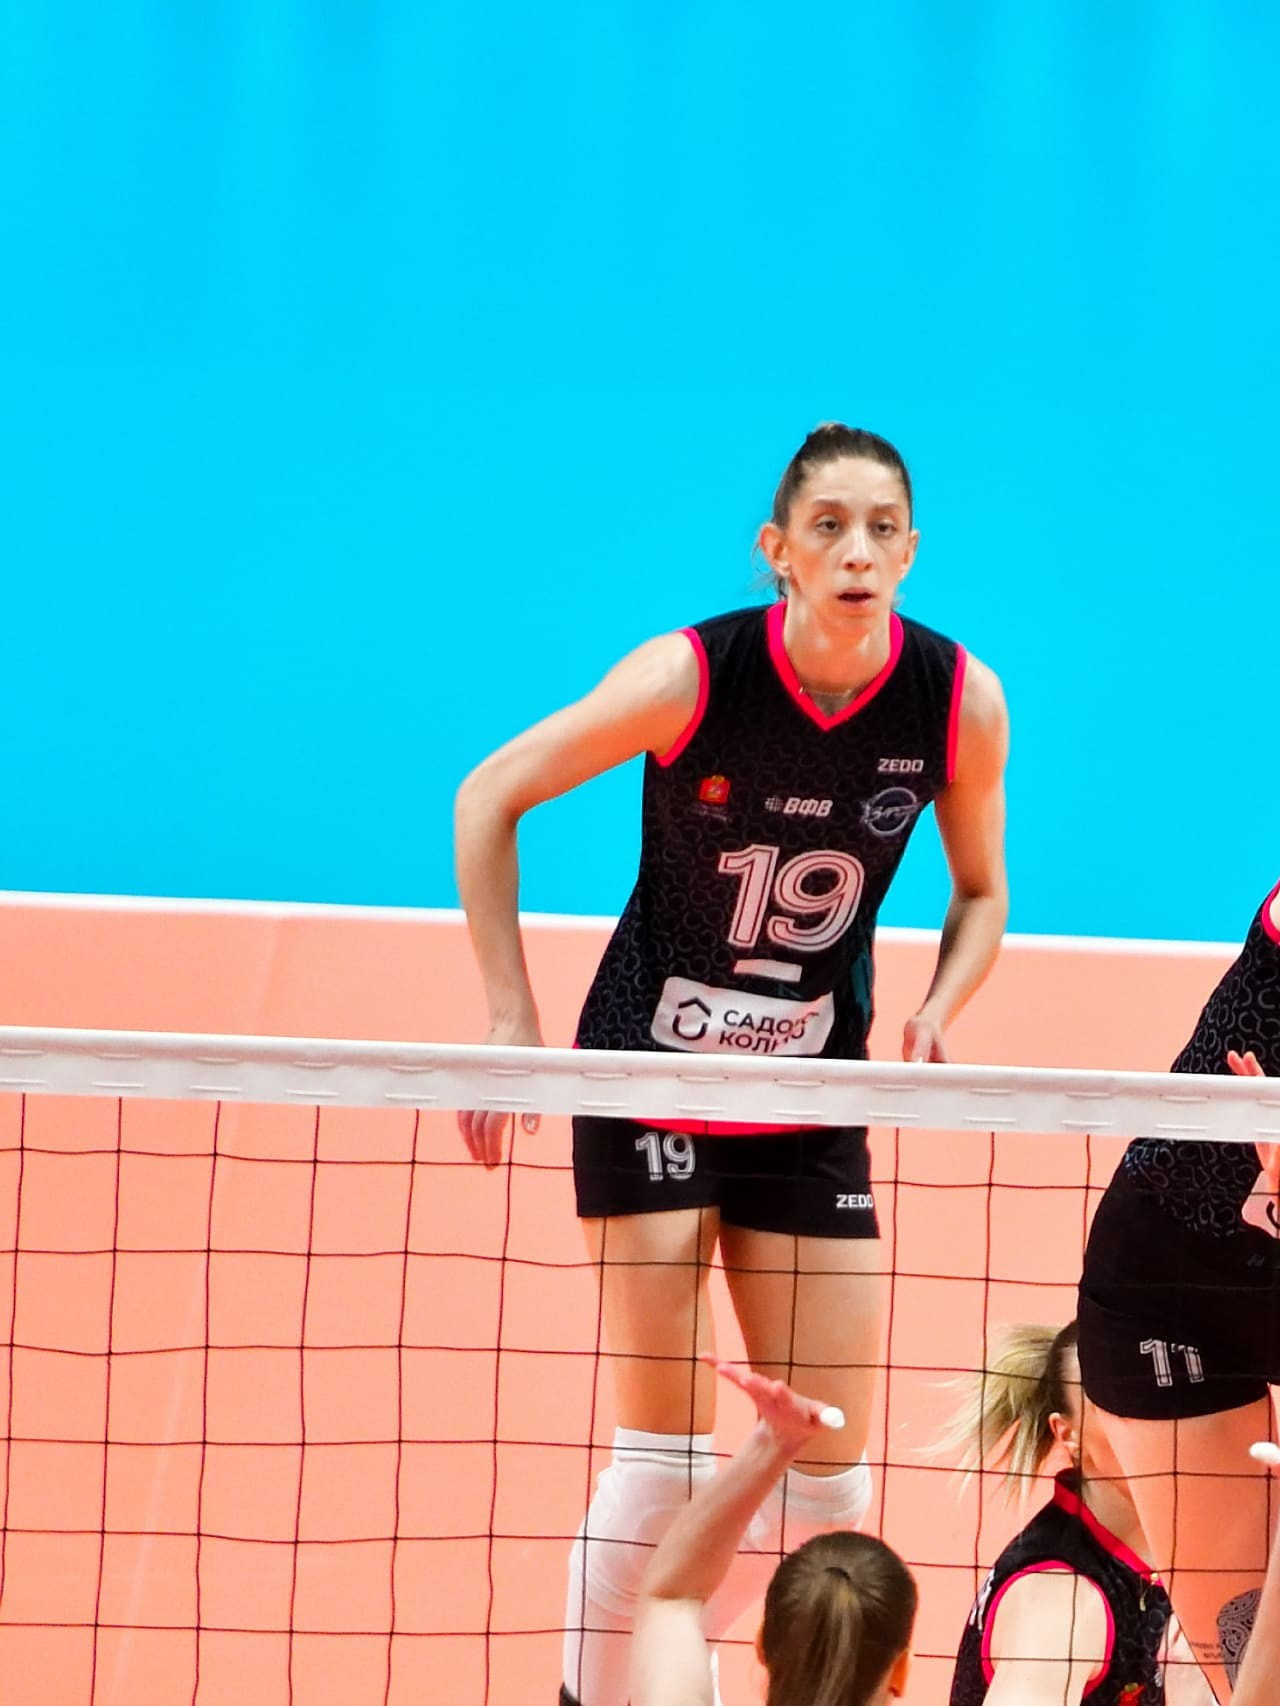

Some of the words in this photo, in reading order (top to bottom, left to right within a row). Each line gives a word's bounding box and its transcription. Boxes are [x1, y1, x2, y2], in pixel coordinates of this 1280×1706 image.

[718, 844, 864, 951] 19
[635, 1131, 696, 1181] 19
[1139, 1337, 1205, 1387] 11
